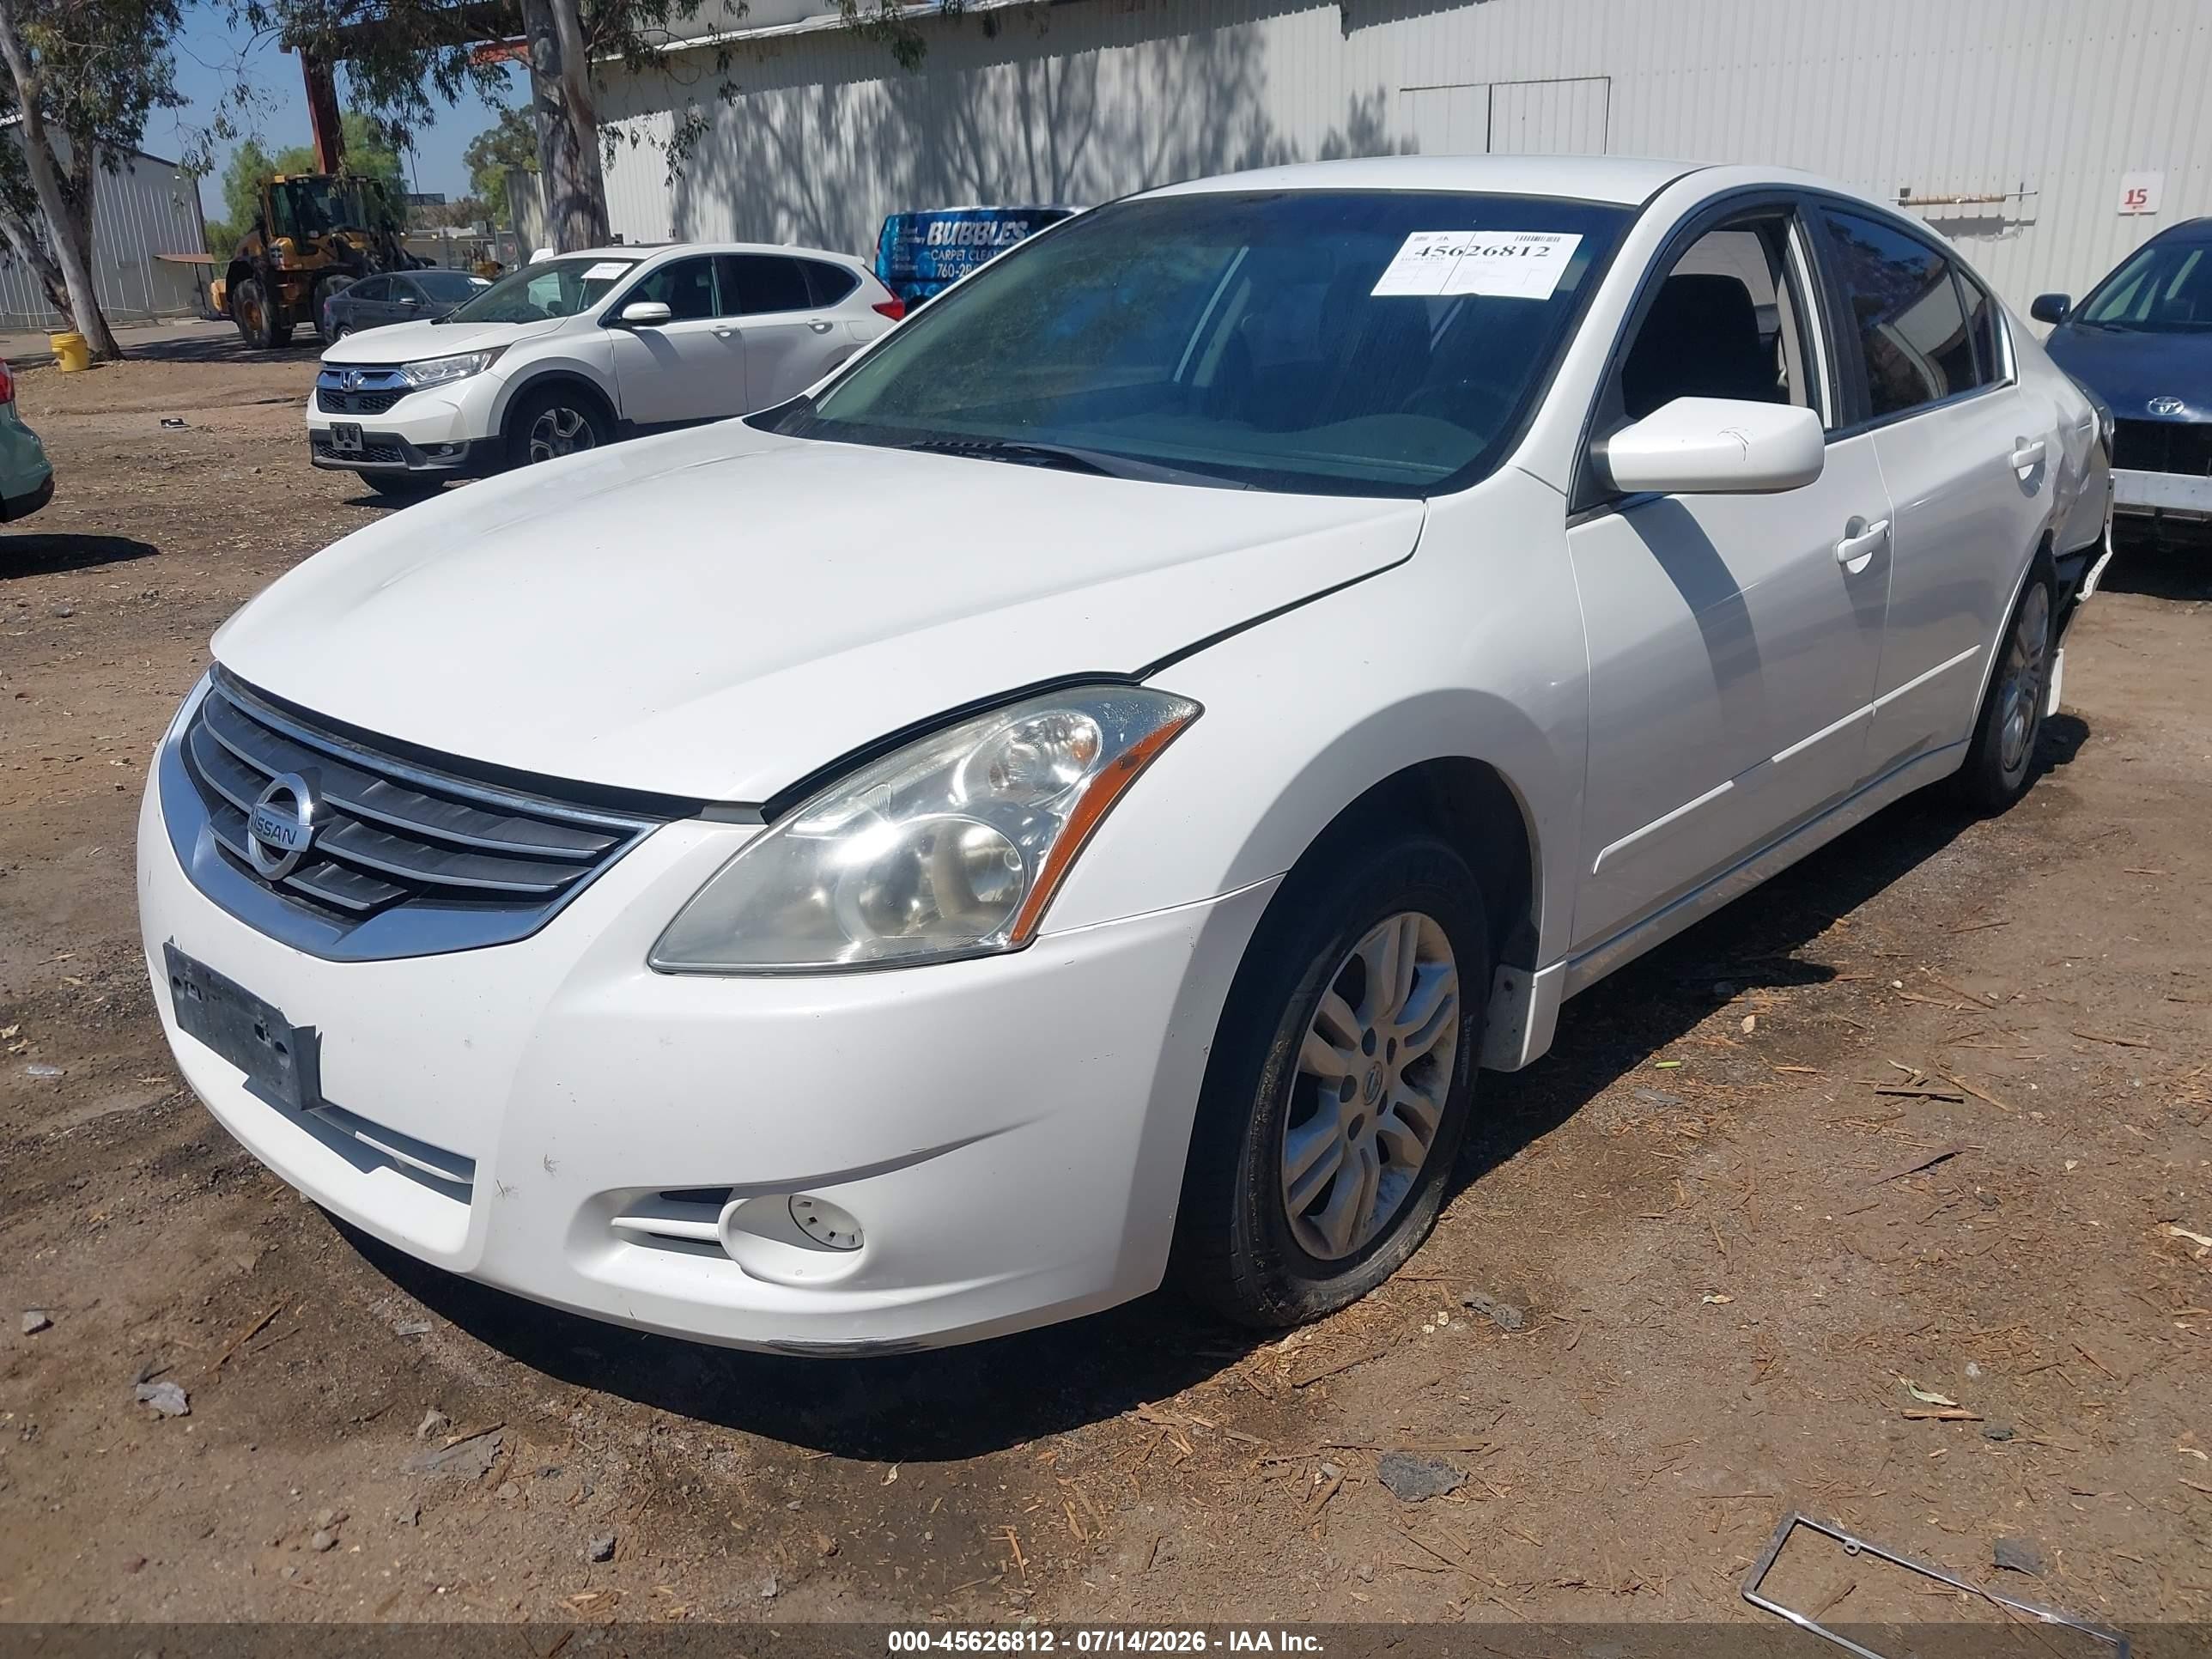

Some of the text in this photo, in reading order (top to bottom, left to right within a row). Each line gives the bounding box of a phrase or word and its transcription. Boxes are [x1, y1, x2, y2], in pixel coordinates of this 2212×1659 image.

[2124, 189, 2148, 204] 15
[927, 221, 1030, 246] BUBBLES
[931, 249, 966, 261] CARPET
[1415, 245, 1551, 257] 45626812
